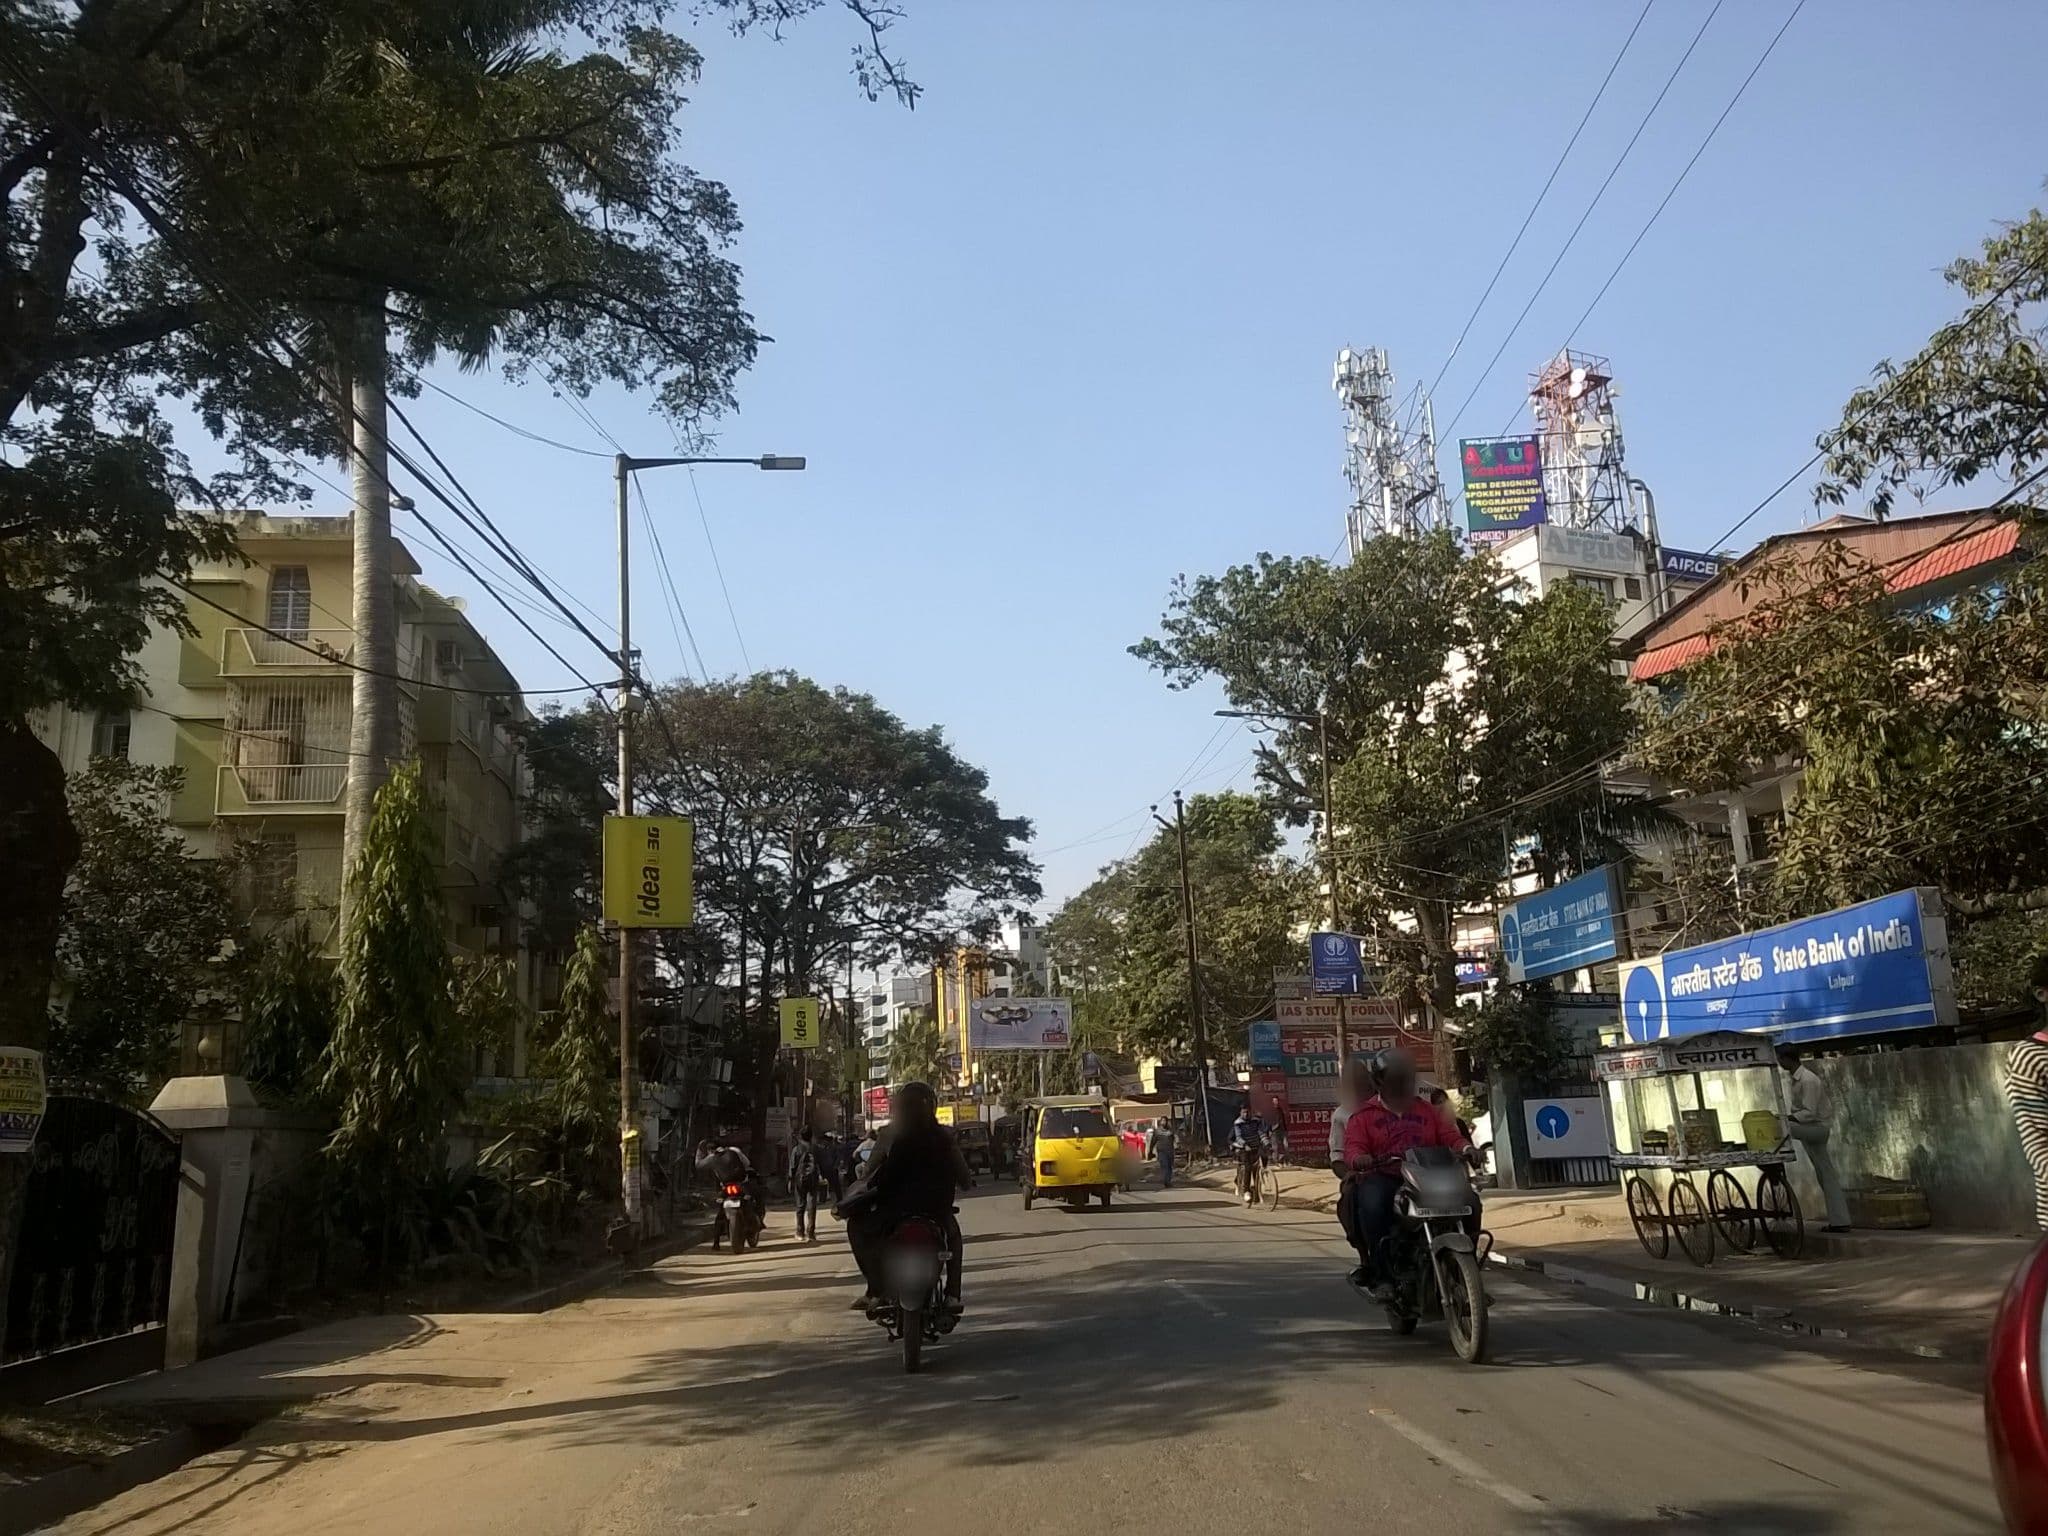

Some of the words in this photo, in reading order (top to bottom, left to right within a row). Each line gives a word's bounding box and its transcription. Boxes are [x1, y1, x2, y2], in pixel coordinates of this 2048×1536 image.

[1489, 479, 1538, 488] DESIGNING
[1465, 490, 1501, 498] SPOKEN
[1503, 487, 1542, 496] ENGLISH
[1470, 496, 1536, 506] PROGRAMMING
[1480, 504, 1530, 514] COMPUTER
[1492, 513, 1520, 521] TALLY
[1667, 556, 1720, 575] AIRCEL
[1772, 945, 1807, 974] State
[1807, 932, 1847, 967] Bank
[1848, 926, 1866, 958] of
[1867, 918, 1913, 954] India
[1454, 962, 1473, 977] DFC
[1670, 963, 1712, 997] भारतीय
[1712, 957, 1738, 989] स्टेट
[1738, 951, 1763, 981] बैंक
[1828, 973, 1855, 992] Lalpur
[1281, 1006, 1302, 1016] IAS
[1306, 1005, 1348, 1016] STUD
[1352, 1005, 1395, 1016] FORUM
[1676, 1048, 1759, 1066] स्वागतम्
